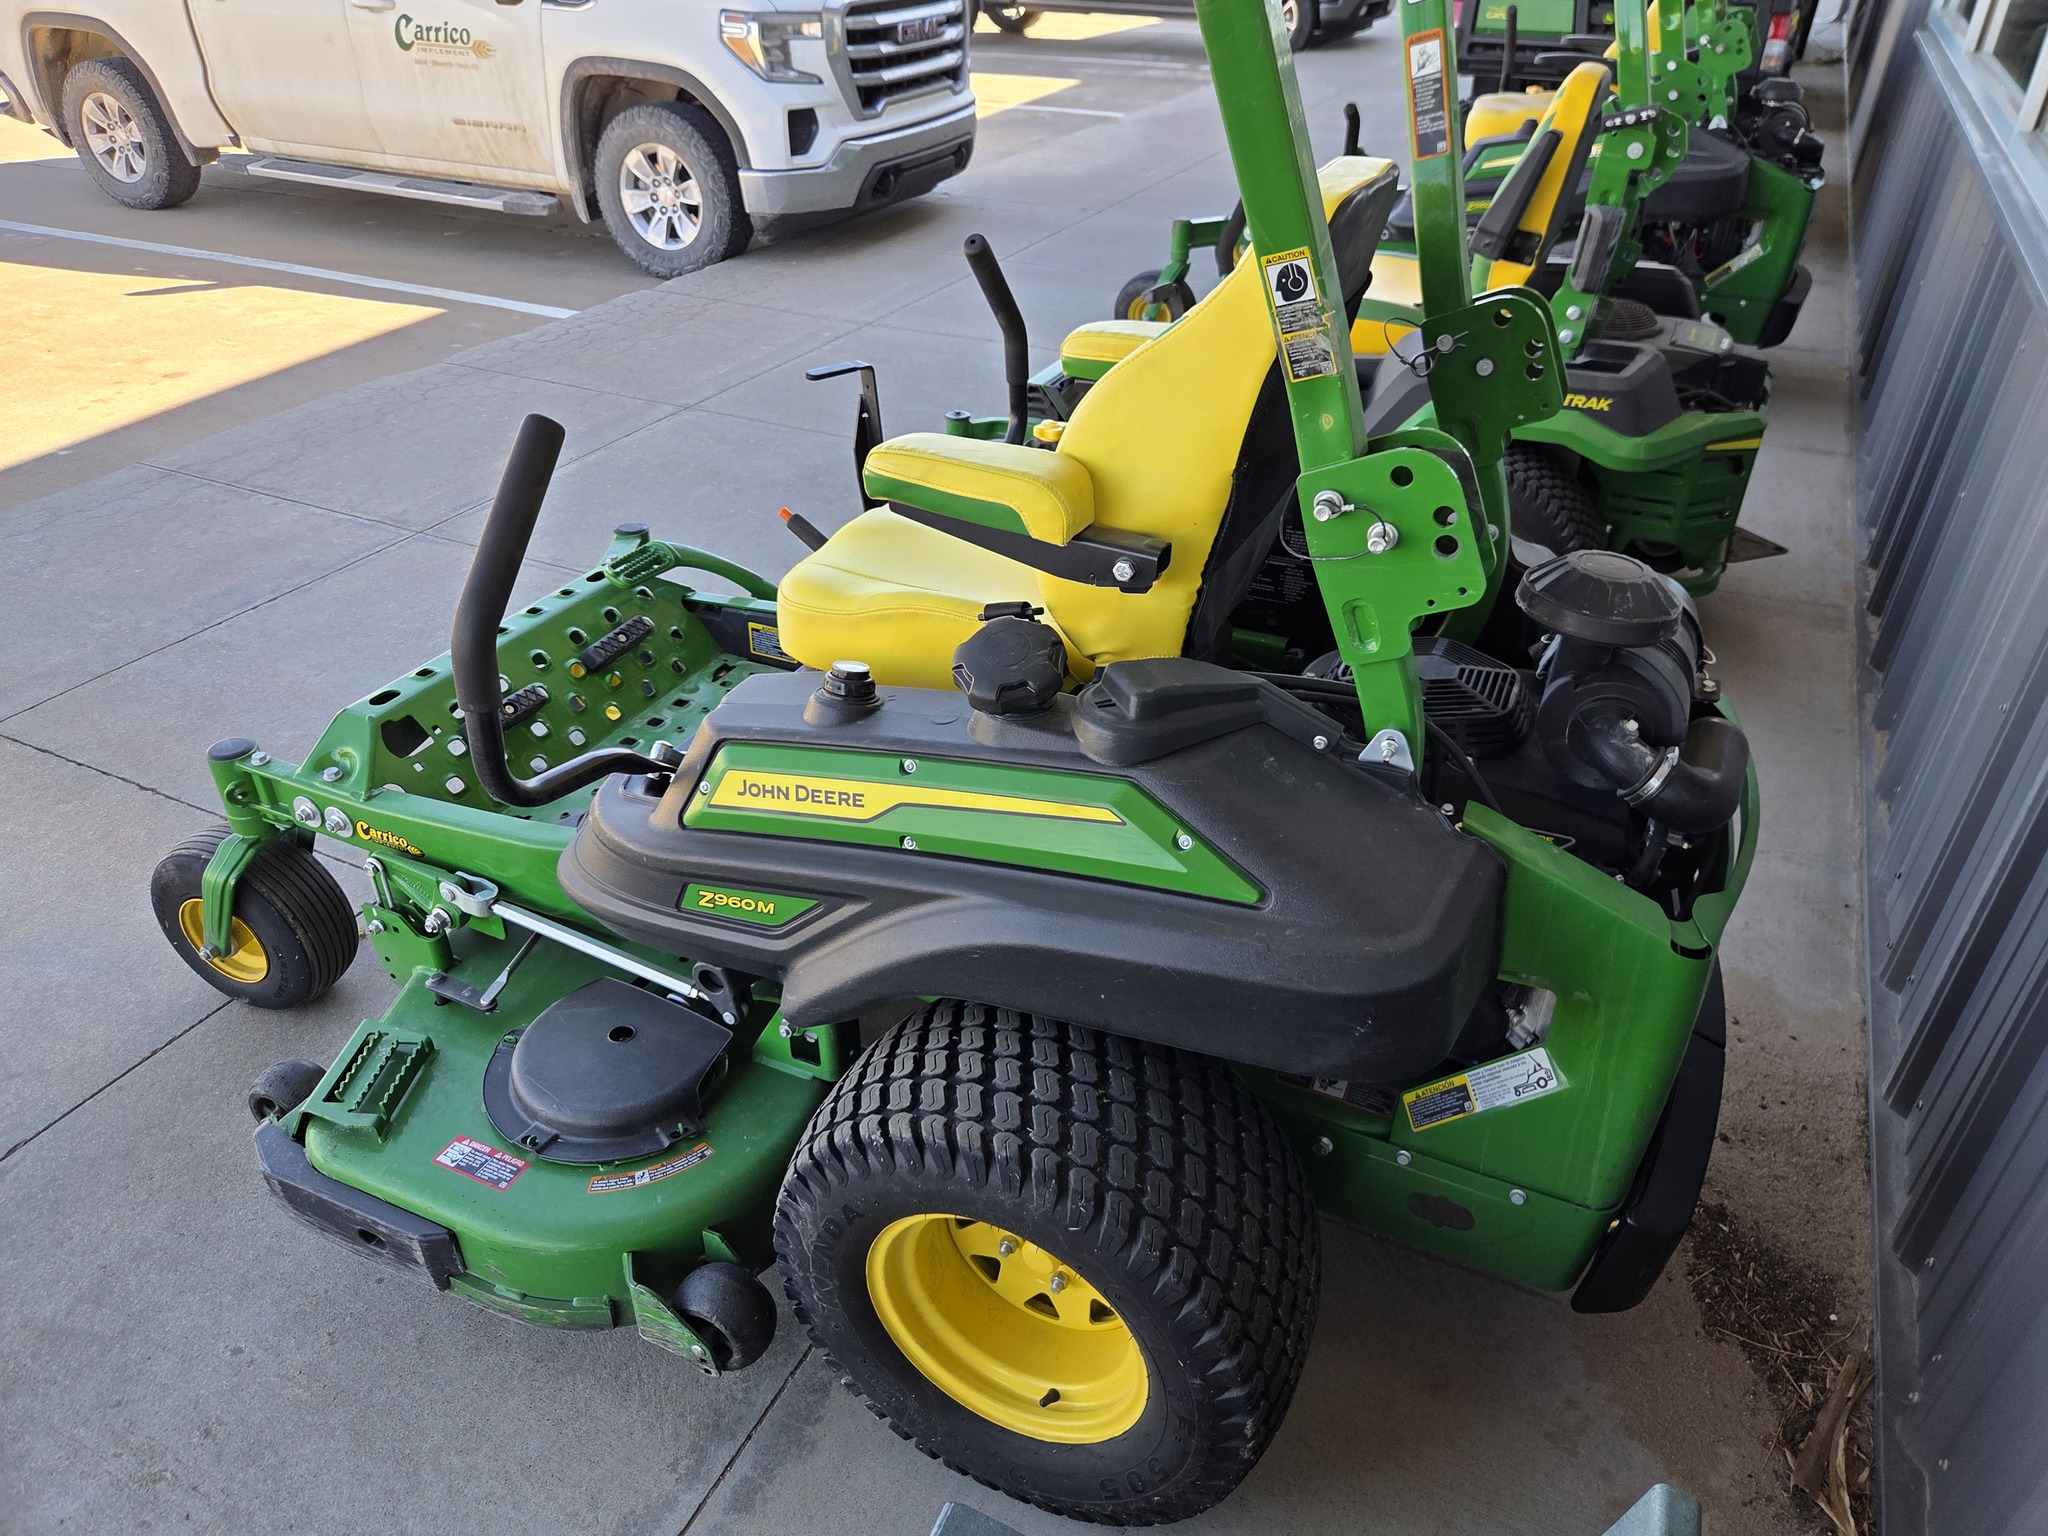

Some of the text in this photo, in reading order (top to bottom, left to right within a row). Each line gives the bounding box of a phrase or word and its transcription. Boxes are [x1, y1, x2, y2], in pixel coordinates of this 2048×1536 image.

[395, 14, 470, 52] Carrico
[897, 15, 947, 44] GMC
[417, 47, 470, 57] IMPLEMENT
[453, 118, 527, 133] SIERRA
[1272, 250, 1306, 262] CAUTION
[737, 779, 865, 808] JOHN DEERE
[356, 820, 408, 848] Carrico
[698, 890, 775, 915] Z960M
[1421, 1081, 1455, 1097] ATENCIÓN
[469, 1141, 492, 1154] DANGER
[501, 1154, 526, 1167] PELIGRO
